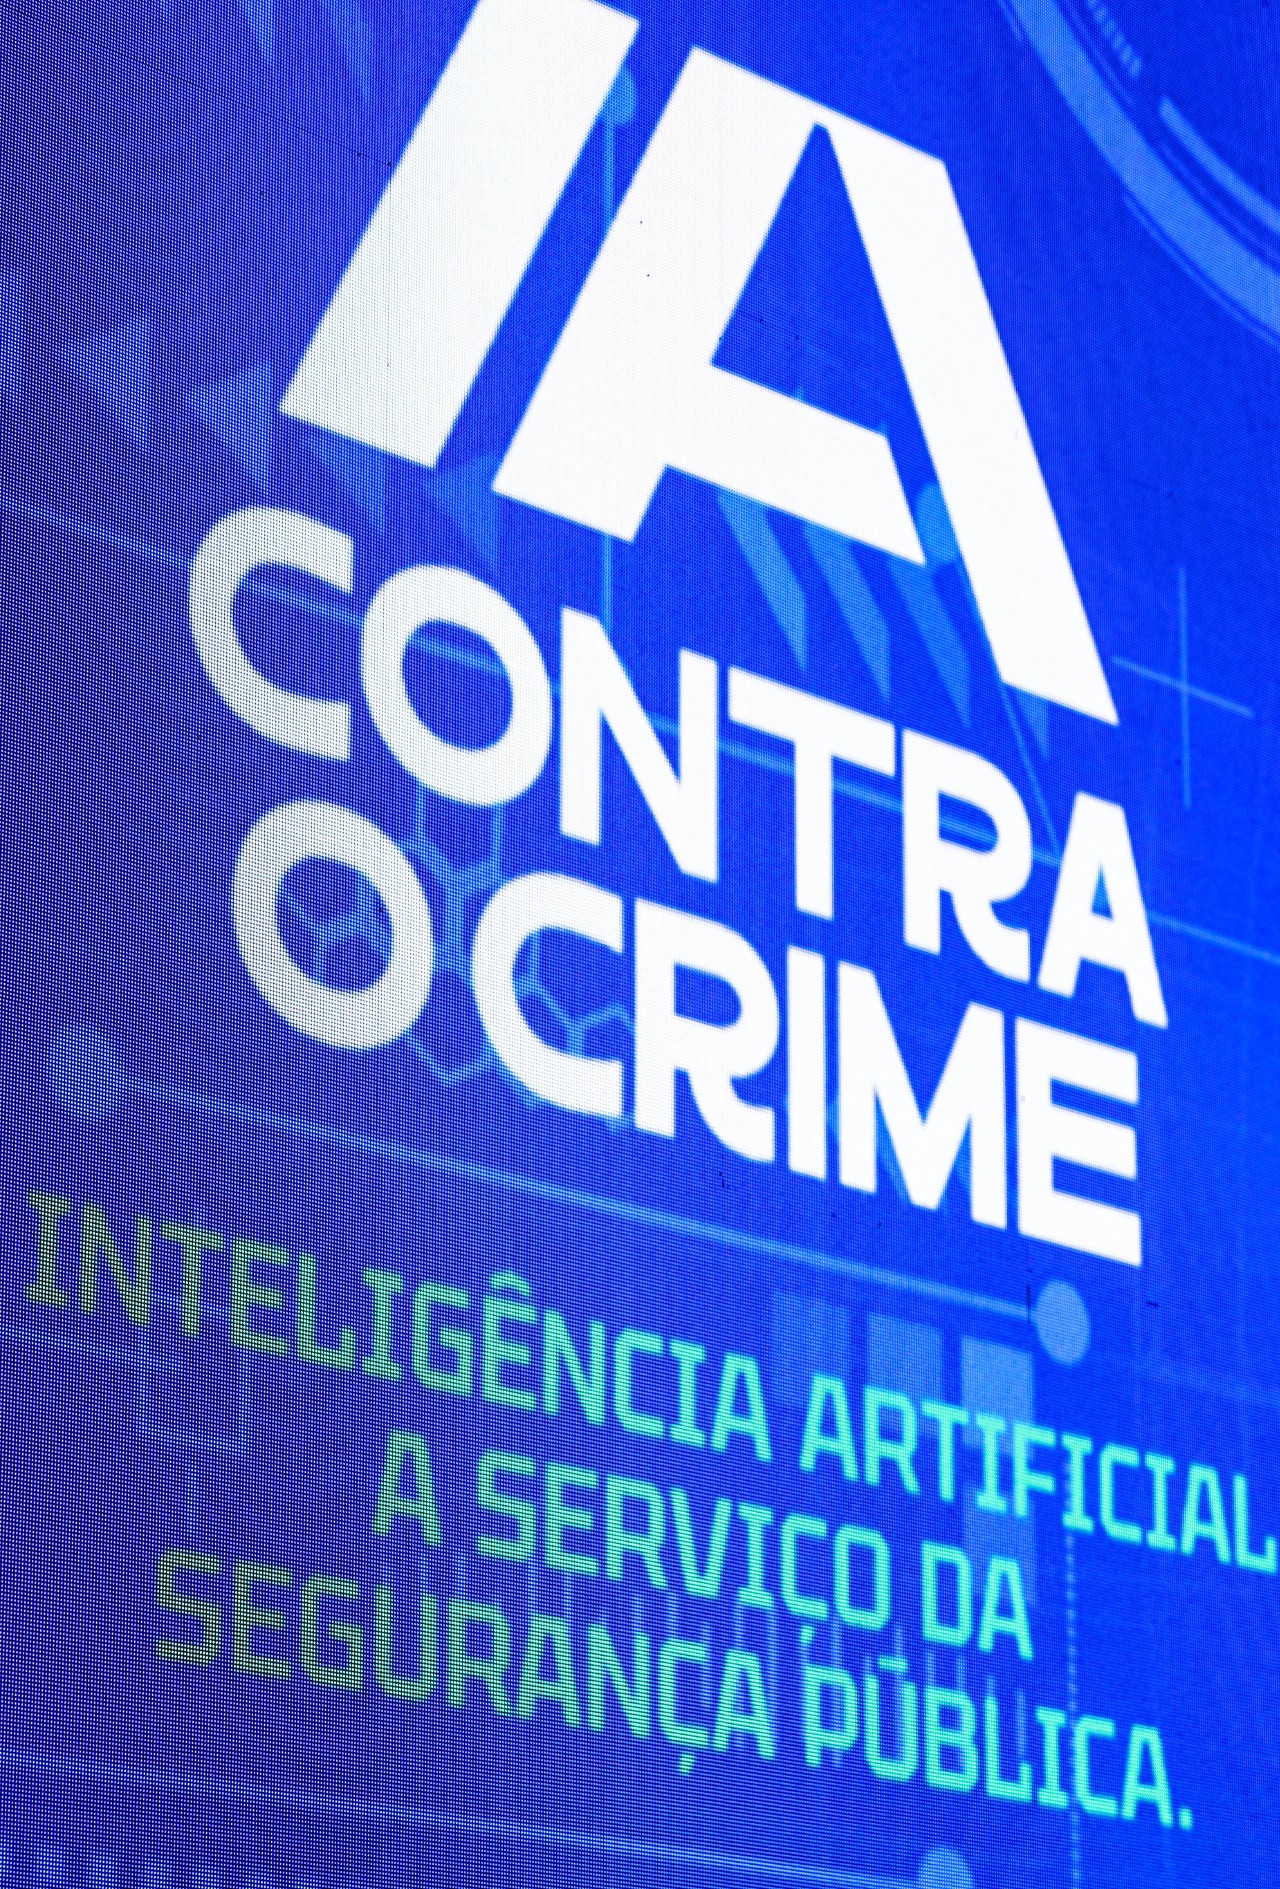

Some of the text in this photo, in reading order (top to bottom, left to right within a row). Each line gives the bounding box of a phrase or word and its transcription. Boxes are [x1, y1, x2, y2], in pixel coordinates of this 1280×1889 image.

[279, 0, 1118, 725] IA
[188, 506, 1168, 1028] CONTRA
[232, 799, 1143, 1267] O CRIME
[27, 1189, 1279, 1575] INTELIGÊNCIA ARTIFICIAL
[371, 1428, 1034, 1661] A SERVIÇO DA
[153, 1547, 1194, 1830] SEGURANÇA PÚBLICA.
